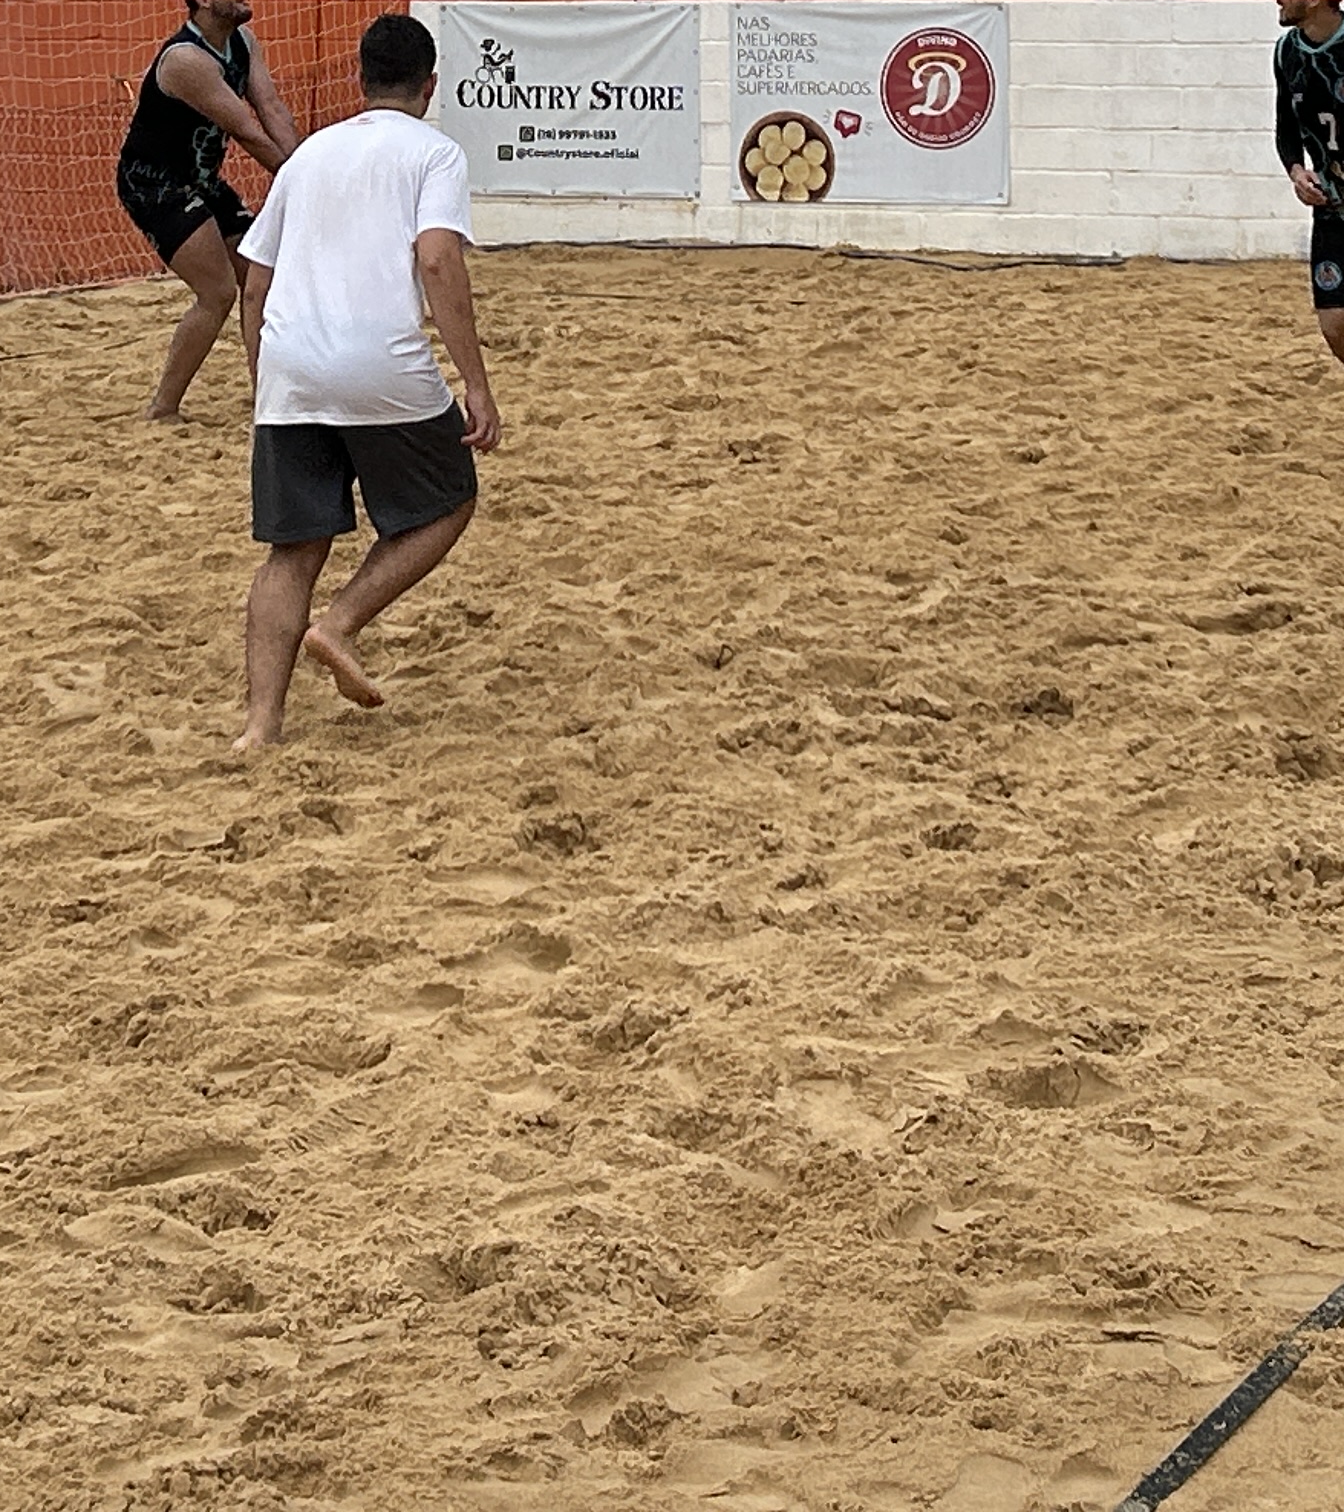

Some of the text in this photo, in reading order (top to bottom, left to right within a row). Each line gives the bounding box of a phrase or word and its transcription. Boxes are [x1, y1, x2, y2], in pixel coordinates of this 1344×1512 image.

[737, 16, 771, 31] NAS
[737, 32, 818, 47] MELHORES
[737, 61, 796, 79] CAFÉS E
[737, 80, 876, 95] SUPERMERCADOS.
[1317, 111, 1340, 151] 7
